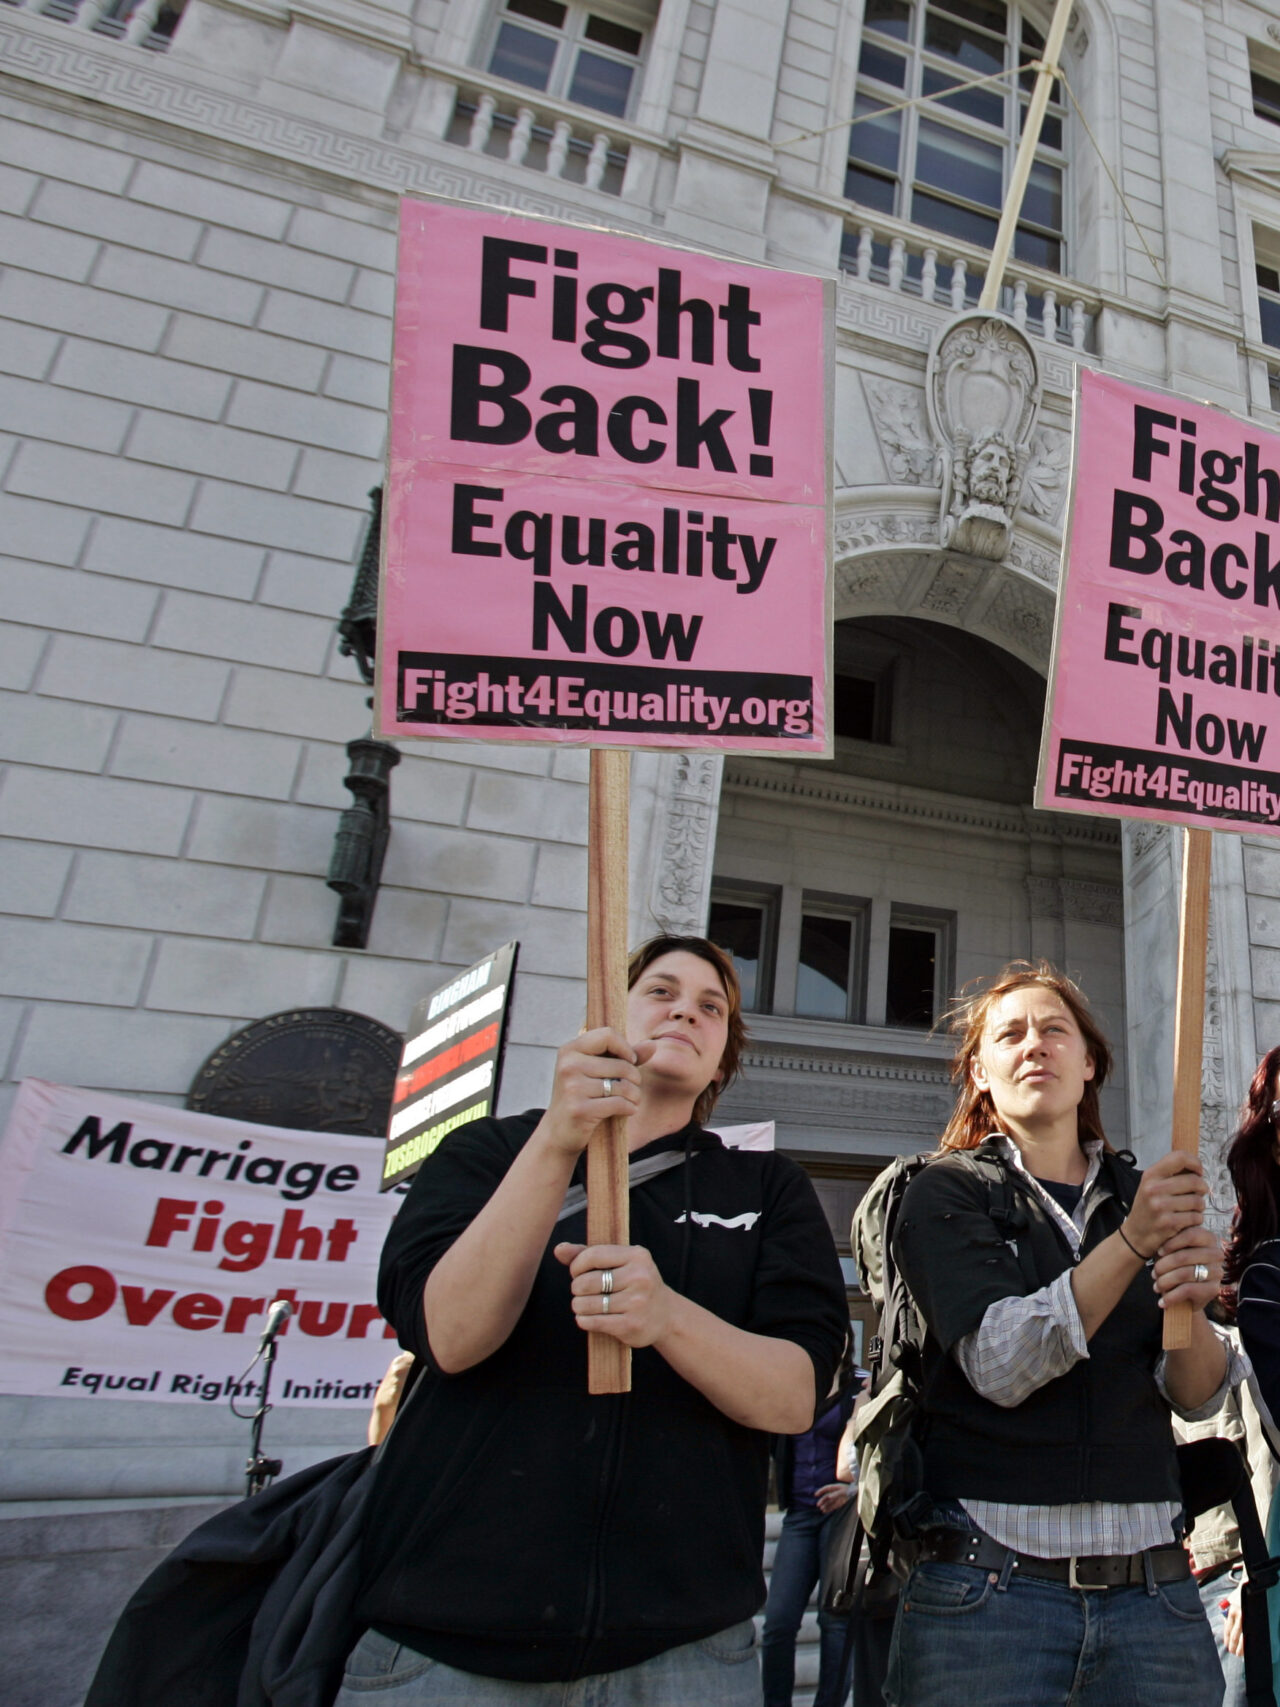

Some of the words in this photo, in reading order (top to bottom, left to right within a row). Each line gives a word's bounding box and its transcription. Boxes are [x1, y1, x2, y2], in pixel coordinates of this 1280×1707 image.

[480, 236, 761, 372] Fight
[450, 343, 773, 477] Back!
[451, 483, 777, 594] Equality
[532, 582, 703, 661] Now
[403, 669, 811, 733] Fight4Equality.org
[1155, 687, 1267, 763] Now
[62, 1115, 360, 1200] Marriage
[145, 1197, 359, 1272] Fight
[61, 1367, 162, 1393] Equal
[171, 1374, 265, 1401] Rights
[282, 1378, 382, 1400] Initiati
